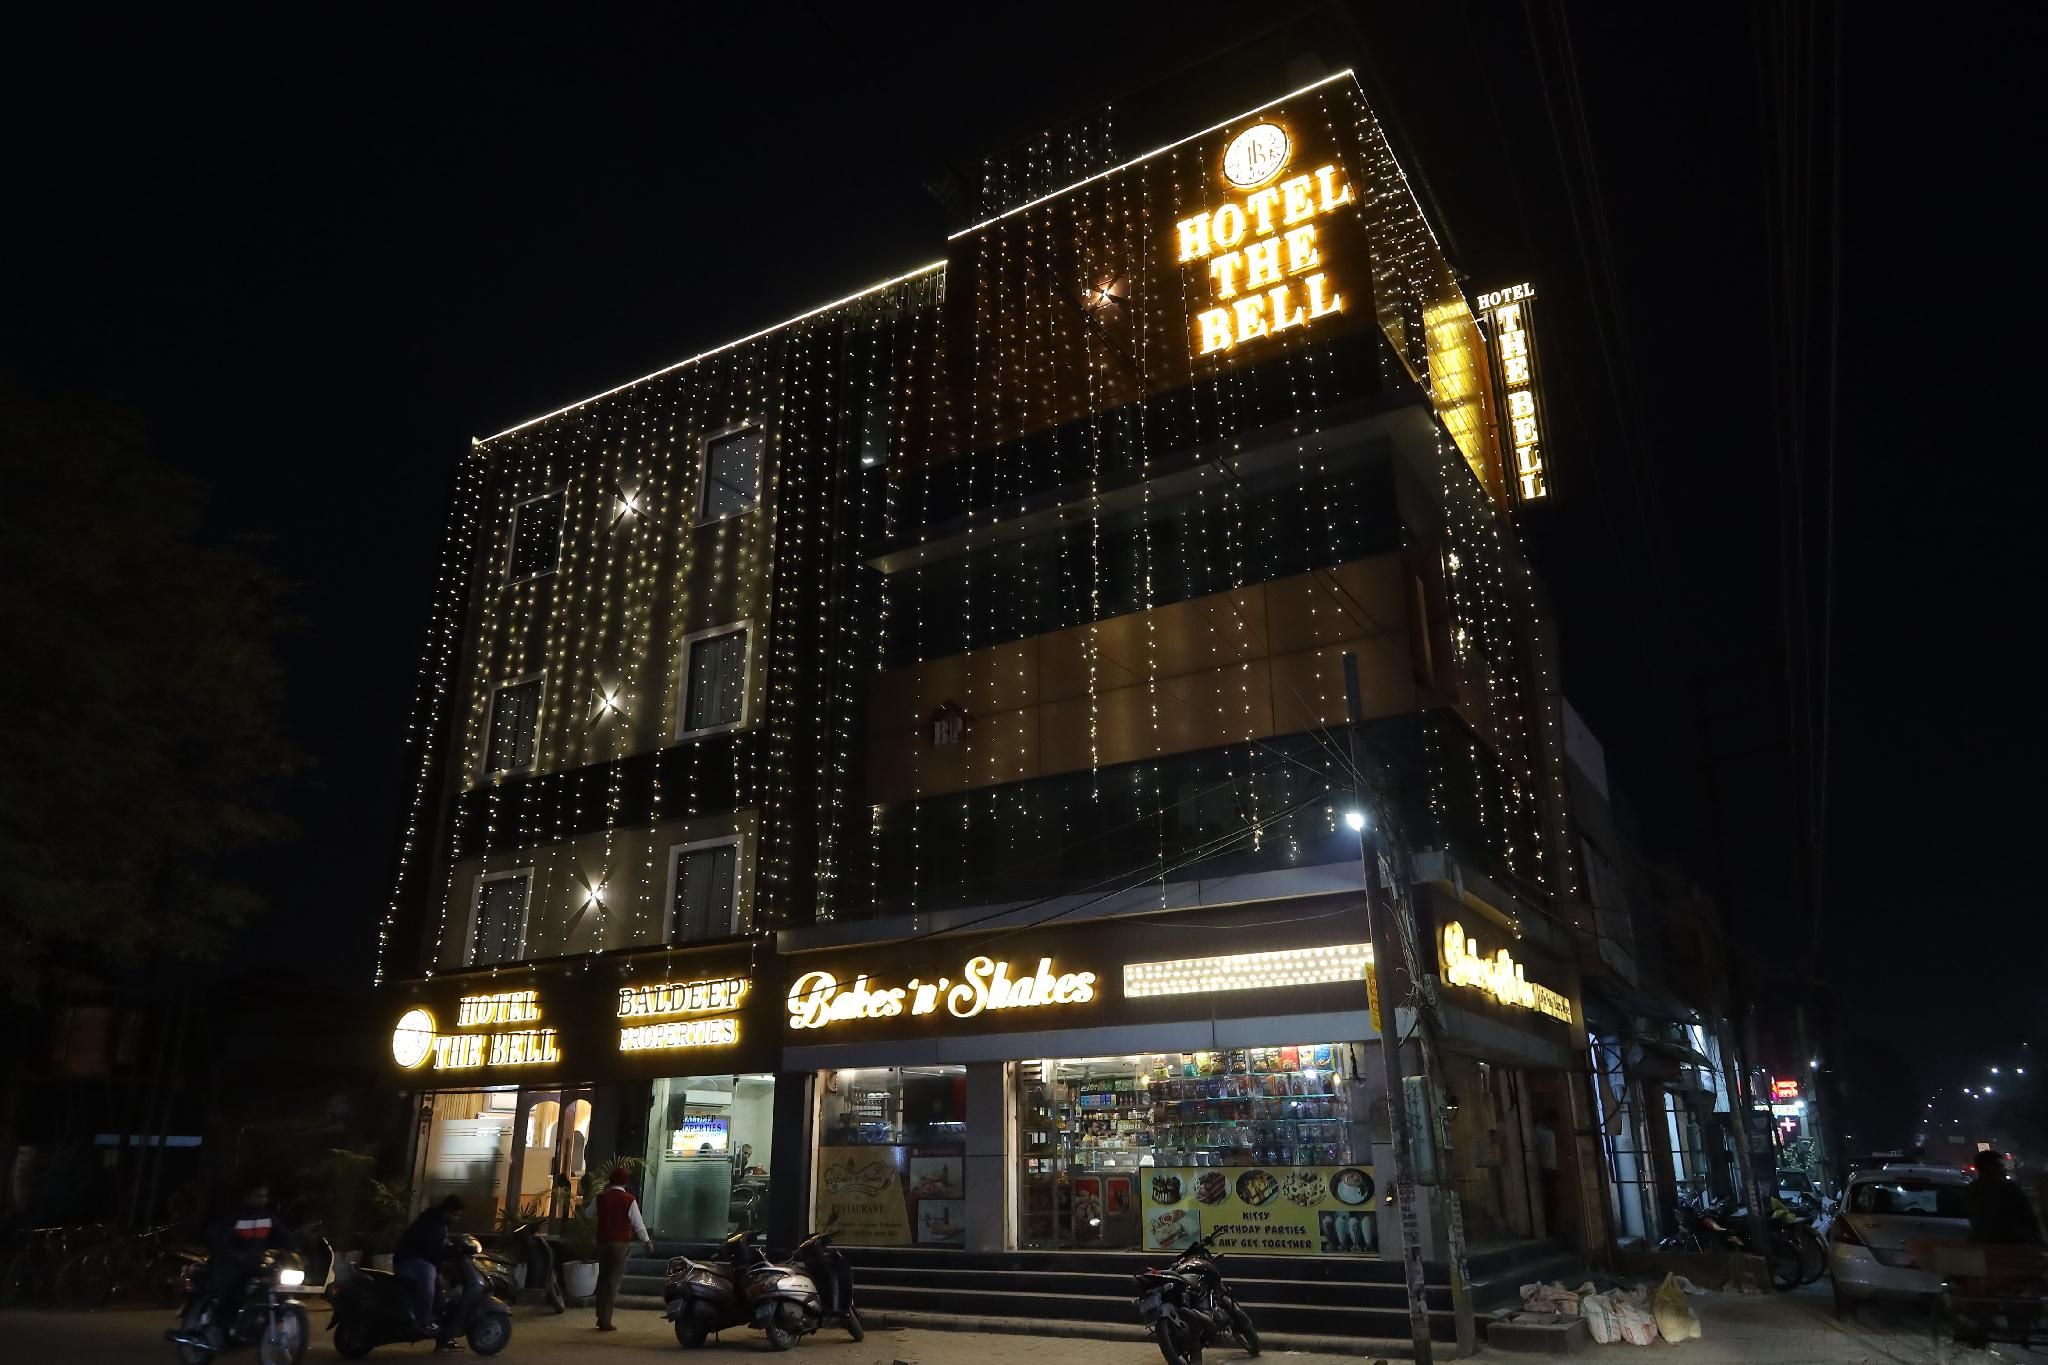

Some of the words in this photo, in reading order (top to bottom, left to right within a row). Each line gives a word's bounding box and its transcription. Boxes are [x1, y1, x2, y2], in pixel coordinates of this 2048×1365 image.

[1176, 164, 1351, 263] HOTEL
[1210, 224, 1320, 300] THE
[1197, 272, 1342, 356] BELL
[1477, 282, 1535, 311] HOTEL
[1497, 303, 1531, 386] THE
[1507, 391, 1547, 501] BELL
[457, 990, 541, 1026] HOTEL
[617, 978, 746, 1018] BALDEEP
[787, 971, 906, 1030] Bakes
[948, 956, 1096, 1018] Shakes
[433, 1034, 486, 1070] THE
[487, 1029, 560, 1066] BELL
[619, 1019, 738, 1051] PROPERTIES
[675, 1123, 722, 1133] OPERTIES
[682, 1115, 716, 1124] ALDEEP
[1242, 1211, 1269, 1221] KITTY
[1264, 1225, 1306, 1235] PARTIES
[1218, 1238, 1237, 1248] ANY
[1240, 1238, 1258, 1248] GET
[1261, 1239, 1313, 1249] TOGETHER
